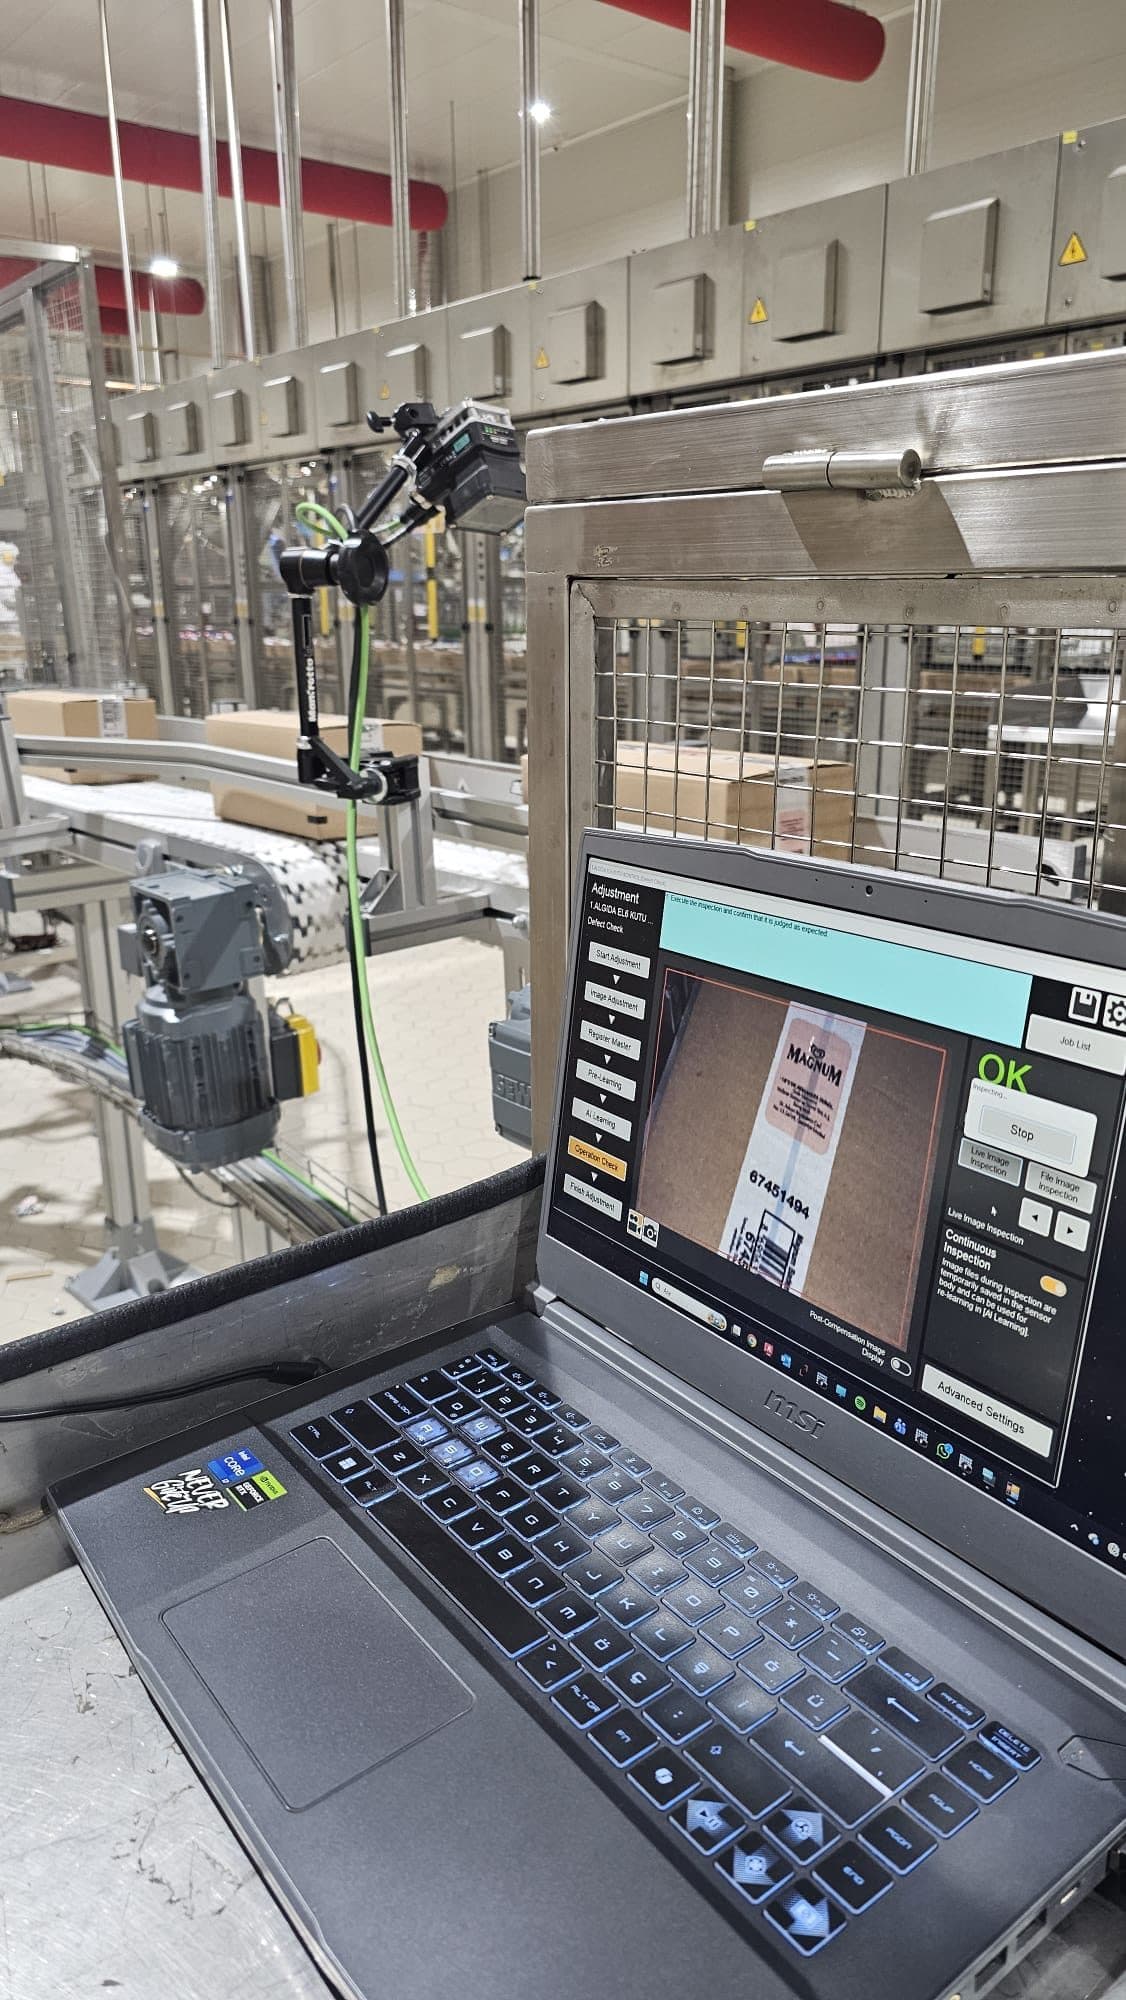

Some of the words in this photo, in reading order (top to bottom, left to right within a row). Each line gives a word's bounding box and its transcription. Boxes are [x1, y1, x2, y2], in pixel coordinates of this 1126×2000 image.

[306, 657, 317, 722] Manfrotto
[591, 882, 640, 905] Adjustment
[629, 911, 648, 923] KUTU
[670, 894, 689, 905] Execute
[689, 899, 698, 908] the
[697, 901, 723, 914] inspection
[723, 908, 733, 916] and
[733, 909, 753, 920] confirm
[753, 914, 763, 923] that
[773, 918, 793, 930] judged
[587, 916, 606, 929] Defect
[606, 920, 624, 933] Check
[596, 949, 609, 960] Start
[609, 953, 641, 970] Adjustment
[590, 989, 607, 1002] Image
[607, 994, 639, 1012] Adjustment
[588, 1028, 611, 1043] Register
[611, 1036, 632, 1051] Master
[1059, 1035, 1075, 1047] Job
[1076, 1039, 1091, 1052] List
[786, 1043, 843, 1087] MAGNUM
[977, 1052, 1033, 1095] OK
[587, 1068, 622, 1092] Pre-Learning
[592, 1111, 616, 1130] Learning
[1010, 1123, 1034, 1142] Stop
[574, 1143, 601, 1163] Operation
[601, 1157, 619, 1172] Check
[970, 1145, 986, 1159] Live
[986, 1151, 1010, 1168] Image
[970, 1157, 1007, 1177] Inspection
[1040, 1170, 1054, 1183] File
[1055, 1174, 1080, 1193] Image
[570, 1181, 585, 1196] Finish
[585, 1190, 615, 1211] Adjustment
[749, 1169, 810, 1220] 67451494
[1038, 1182, 1078, 1204] Inspection
[947, 1206, 963, 1221] Live
[963, 1211, 986, 1231] Image
[986, 1221, 1025, 1246] Inspection
[945, 1228, 997, 1259] Continuous
[943, 1241, 992, 1271] Inspection
[940, 1267, 979, 1292] temporarily
[979, 1285, 1003, 1301] saved
[1002, 1295, 1011, 1306] in
[1011, 1298, 1024, 1312] the
[1024, 1306, 1052, 1324] sensor
[942, 1257, 964, 1274] Image
[964, 1266, 979, 1281] files
[980, 1273, 1003, 1293] during
[1003, 1284, 1043, 1309] inspection
[1043, 1304, 1057, 1316] are
[937, 1287, 974, 1312] re-learning
[974, 1305, 982, 1317] in
[938, 1277, 956, 1292] body
[957, 1286, 971, 1298] and
[971, 1292, 985, 1304] can
[985, 1297, 996, 1310] be
[996, 1304, 1016, 1320] used
[1016, 1312, 1028, 1324] for
[809, 1309, 867, 1347] Post-Compensation
[866, 1340, 887, 1356] Image
[861, 1347, 885, 1367] Display
[451, 1402, 464, 1411] Q
[498, 1395, 512, 1405] 2
[937, 1380, 984, 1412] Advanced
[985, 1405, 1026, 1435] Settings
[524, 1414, 537, 1424] 3
[762, 1390, 826, 1439] msi
[307, 1425, 321, 1439] CTRL
[553, 1435, 565, 1445] 4
[527, 1464, 541, 1474] R
[417, 1474, 431, 1485] X
[608, 1480, 622, 1490] 6
[178, 1468, 230, 1512] NEVER
[235, 1485, 248, 1496] RTX
[243, 1481, 265, 1504] GEFORCE
[496, 1489, 510, 1498] F
[557, 1487, 570, 1496] T
[443, 1497, 457, 1508] C
[641, 1504, 653, 1514] 7
[525, 1514, 539, 1526] G
[587, 1512, 601, 1521] Y
[471, 1522, 485, 1532] V
[671, 1530, 687, 1541] 8
[498, 1548, 513, 1560] B
[553, 1540, 570, 1552] H
[586, 1570, 602, 1580] J
[651, 1567, 664, 1576] I
[618, 1597, 636, 1610] K
[655, 1628, 666, 1641] L
[723, 1625, 741, 1637] P
[594, 1638, 611, 1651] Ö
[629, 1671, 648, 1685] Ç
[570, 1684, 590, 1702] ALT
[586, 1700, 601, 1713] GR
[991, 1735, 1023, 1759] INSERT
[997, 1727, 1031, 1753] DELETE
[967, 1759, 995, 1781] HOME
